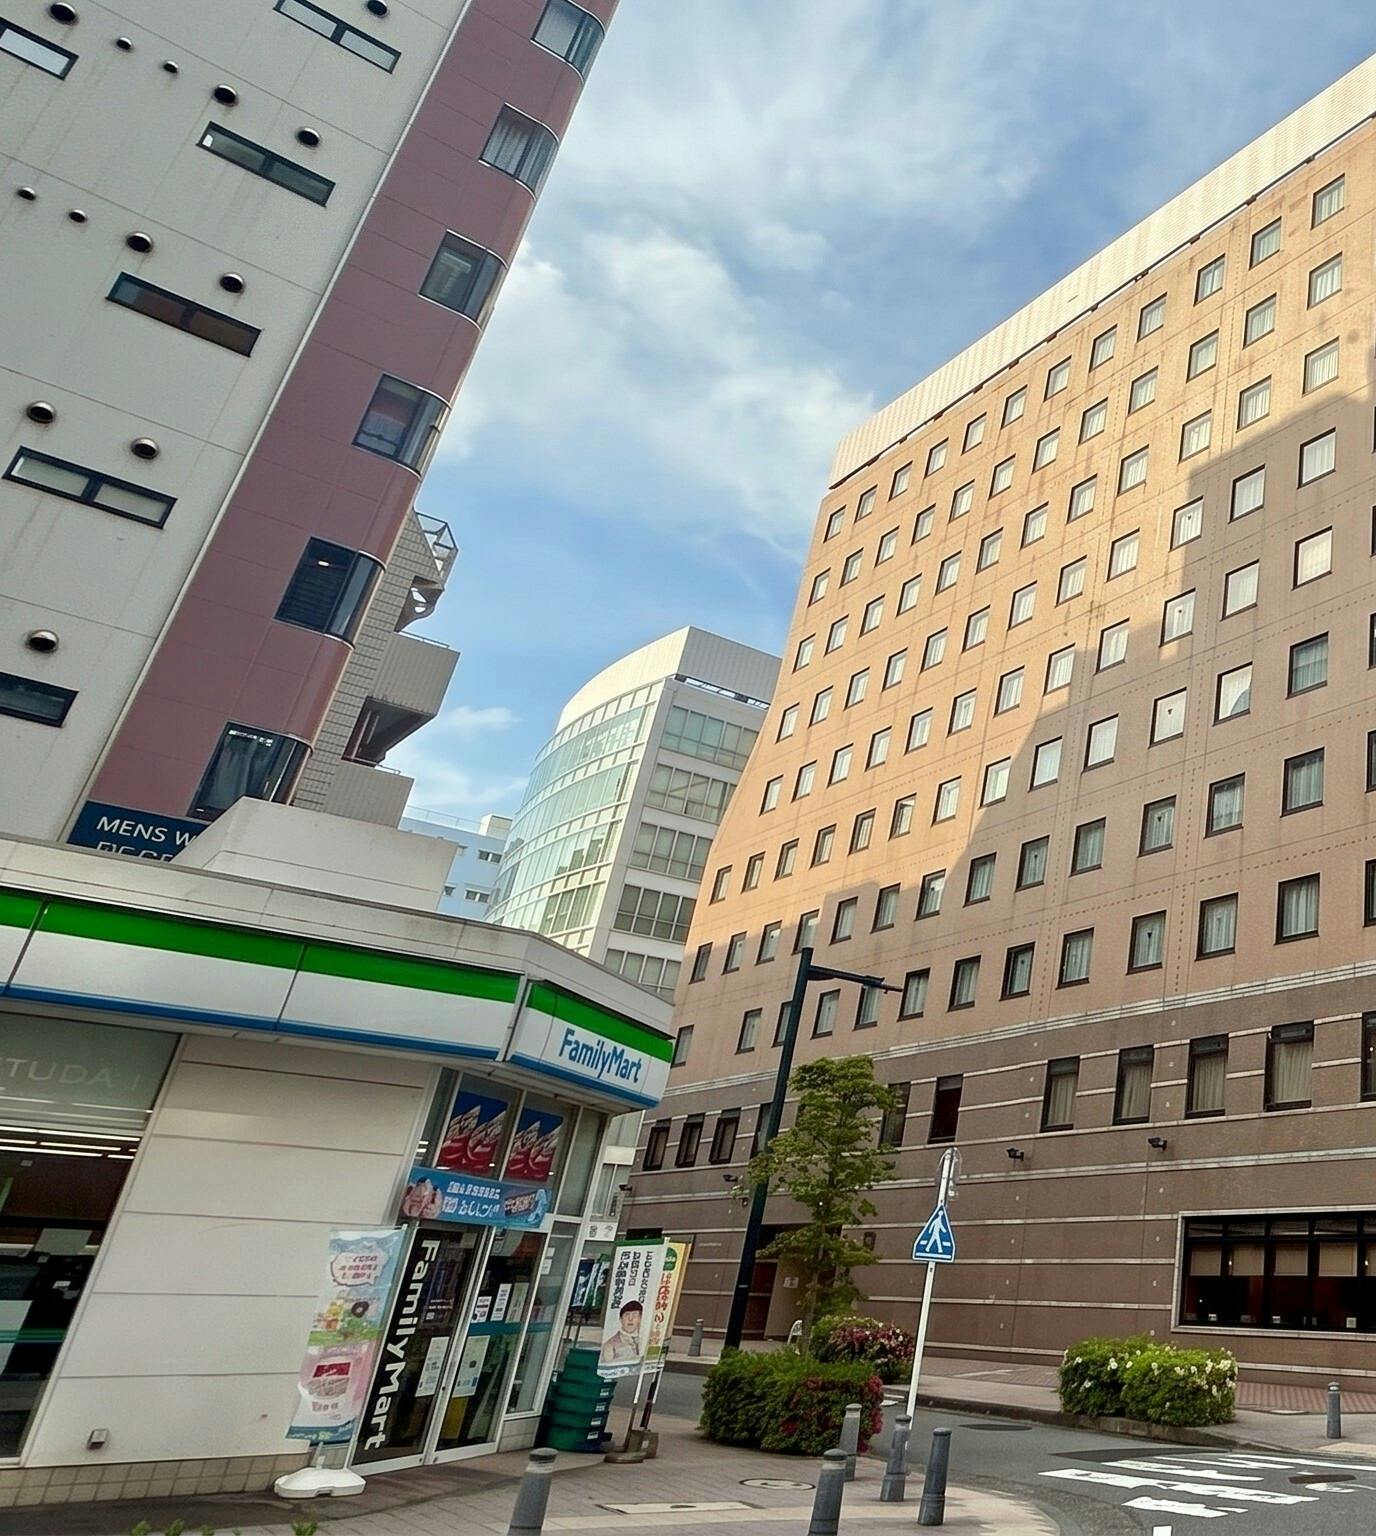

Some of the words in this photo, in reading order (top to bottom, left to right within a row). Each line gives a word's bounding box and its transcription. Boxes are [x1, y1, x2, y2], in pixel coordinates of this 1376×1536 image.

[96, 816, 168, 842] MENS
[558, 1027, 642, 1083] FamilyMart
[364, 1240, 440, 1450] FamilyMart
